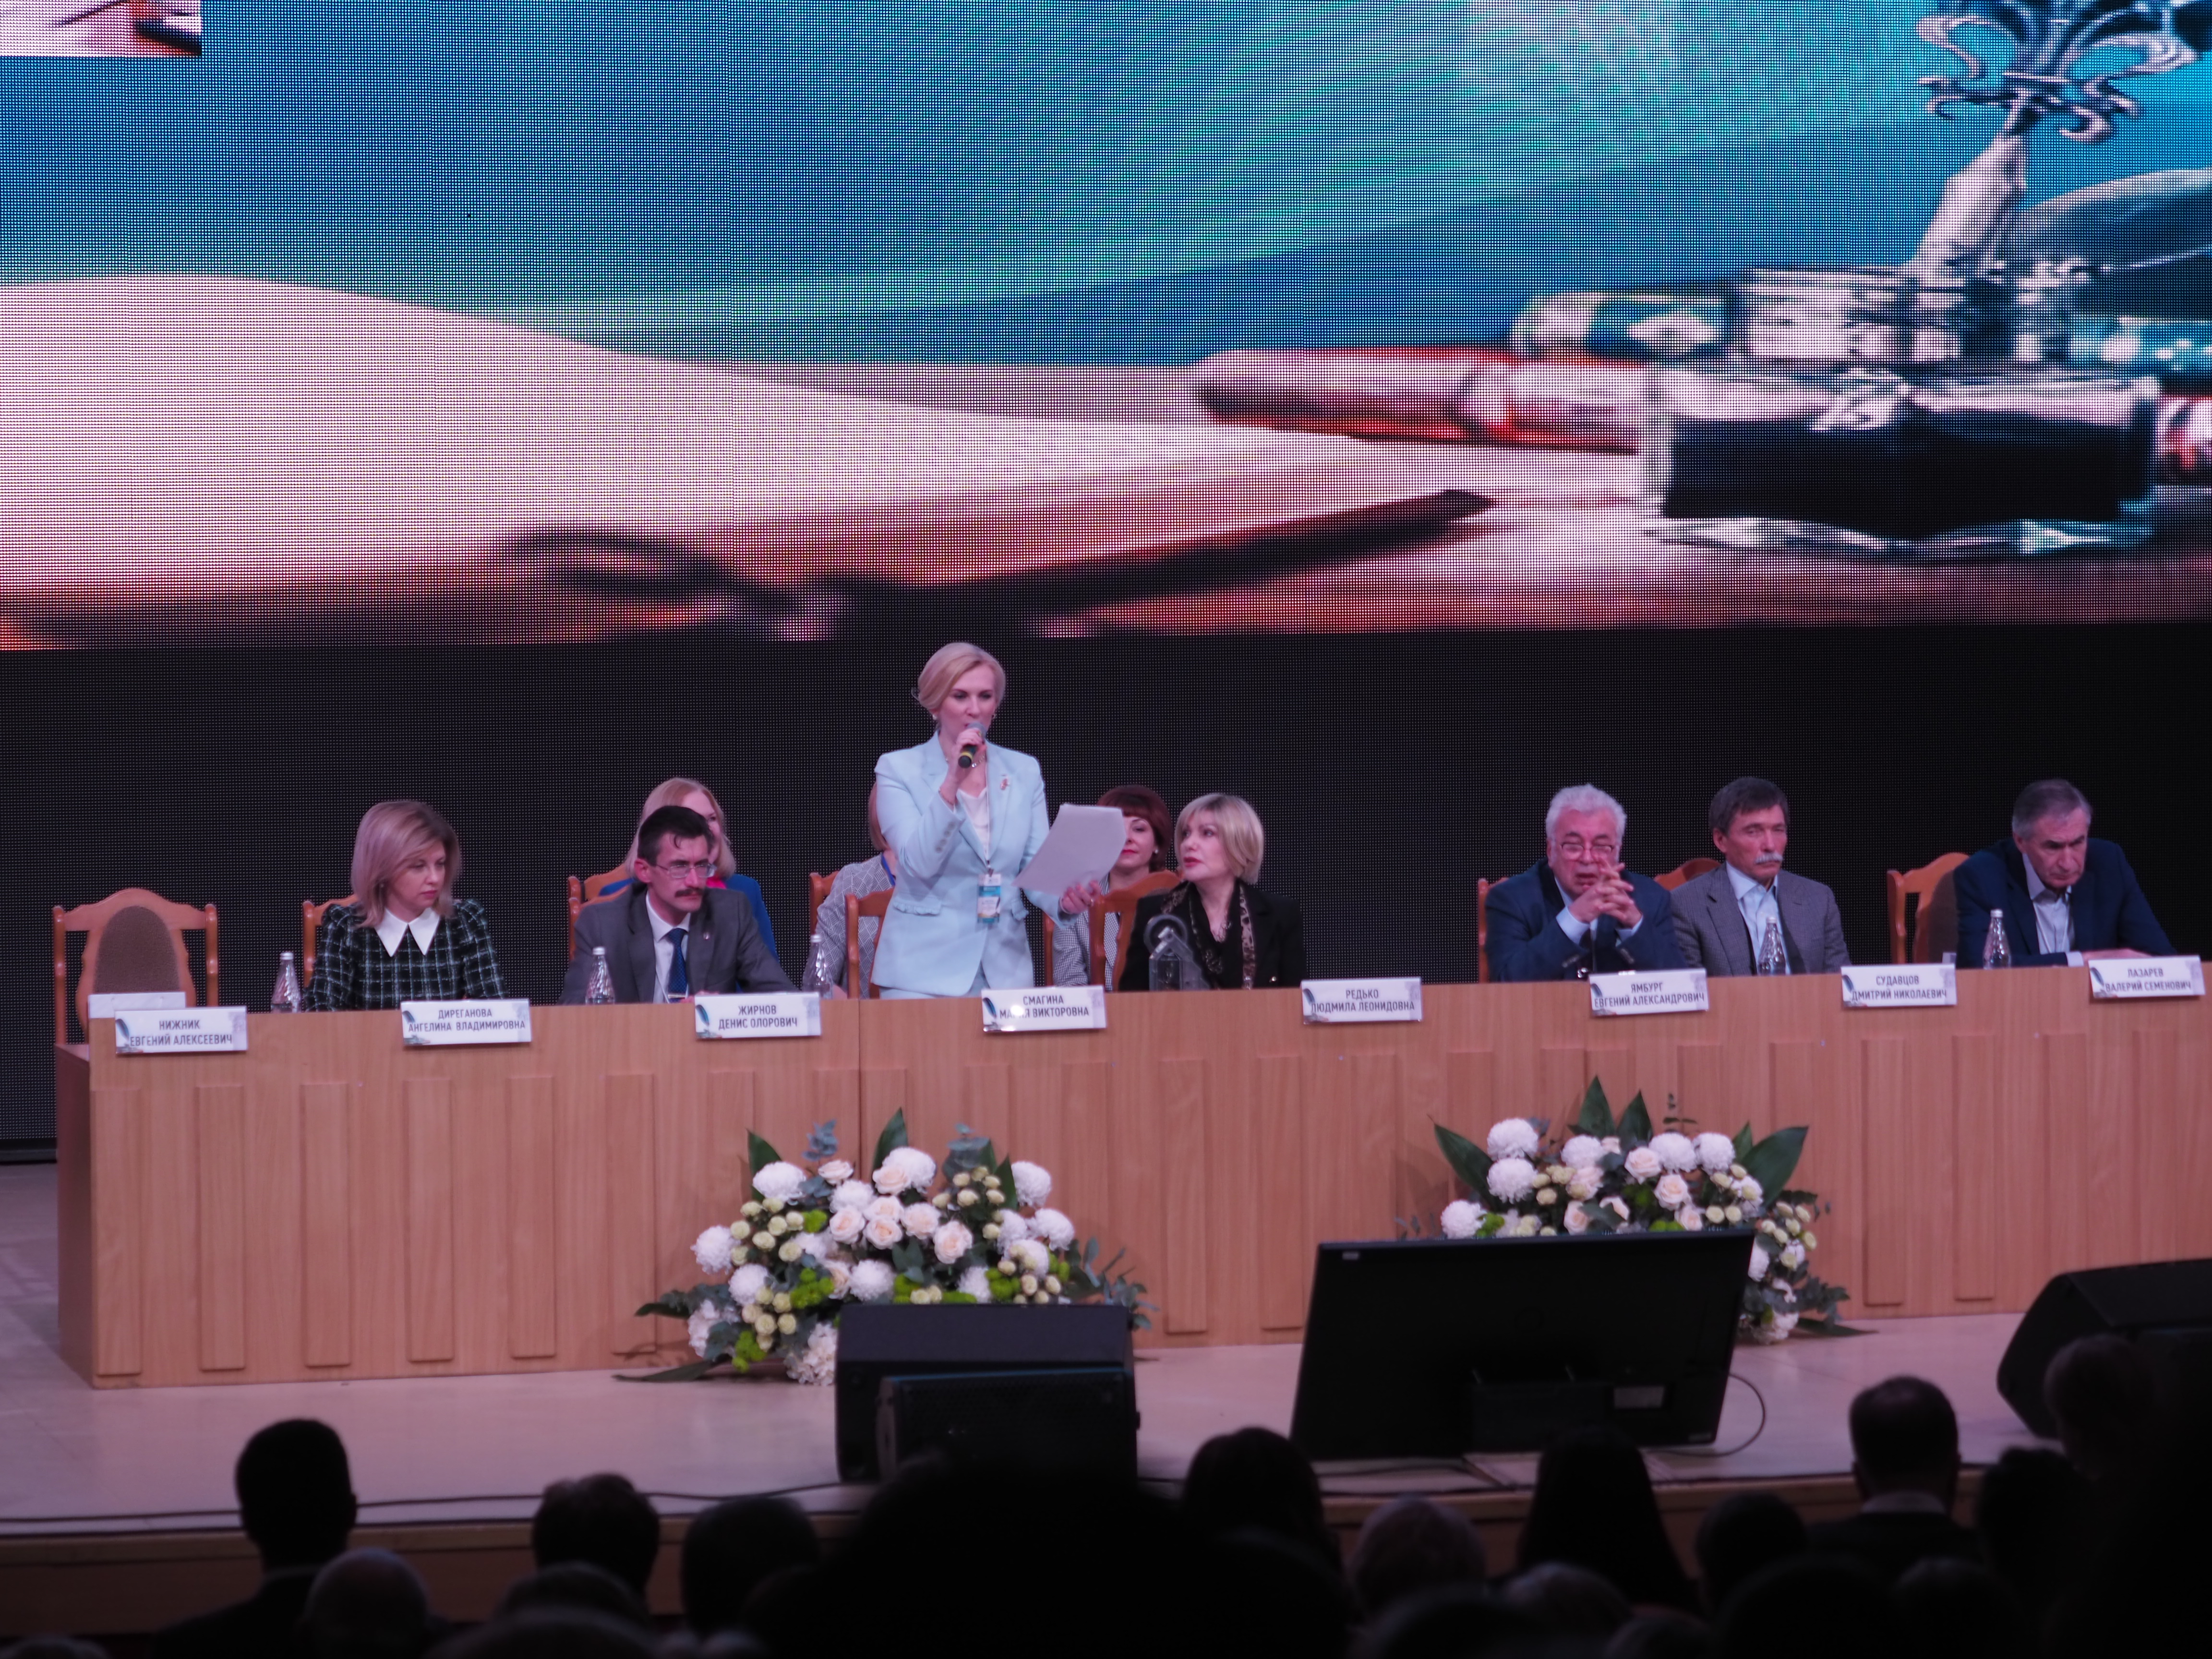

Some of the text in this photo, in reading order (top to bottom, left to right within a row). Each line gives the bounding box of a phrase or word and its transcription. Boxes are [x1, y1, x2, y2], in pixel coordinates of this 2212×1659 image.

[2128, 968, 2164, 977] ЛАЗАРЕВ
[1876, 975, 1919, 986] СУДАВЦОВ
[1631, 983, 1663, 993] ЯМБУРГ
[2105, 981, 2191, 992] ВАЛЕРИЙ СЕМЕНОВИЧ
[1023, 995, 1064, 1005] СМАГИНА
[1346, 989, 1378, 1000] РЕДЬКО
[1852, 988, 1947, 1001] ДМИТРИЙ НИКОЛАЕВИЧ
[1594, 993, 1704, 1008] ЕВГЕНИЙ АЛЕКСАНДРОВИЧ
[738, 1005, 776, 1015] ЖИРНОВ
[1311, 1001, 1415, 1013] ЛЮДМИЛА ЛЕОНИДОВНА
[438, 1009, 492, 1020] ДИРЕГАНОВА
[1000, 1007, 1089, 1019] МАЯ ВИКТОРОВНА
[159, 1020, 200, 1030] НИЖНИК
[409, 1021, 525, 1032] АНГЕЛИНА ВЛАДИМИРОВНА
[718, 1017, 797, 1030] ДЕНИС ОЛОРОВИЧ
[130, 1034, 232, 1046] ЕВГЕНИЙ АЛЕКСЕЕВИЧ
